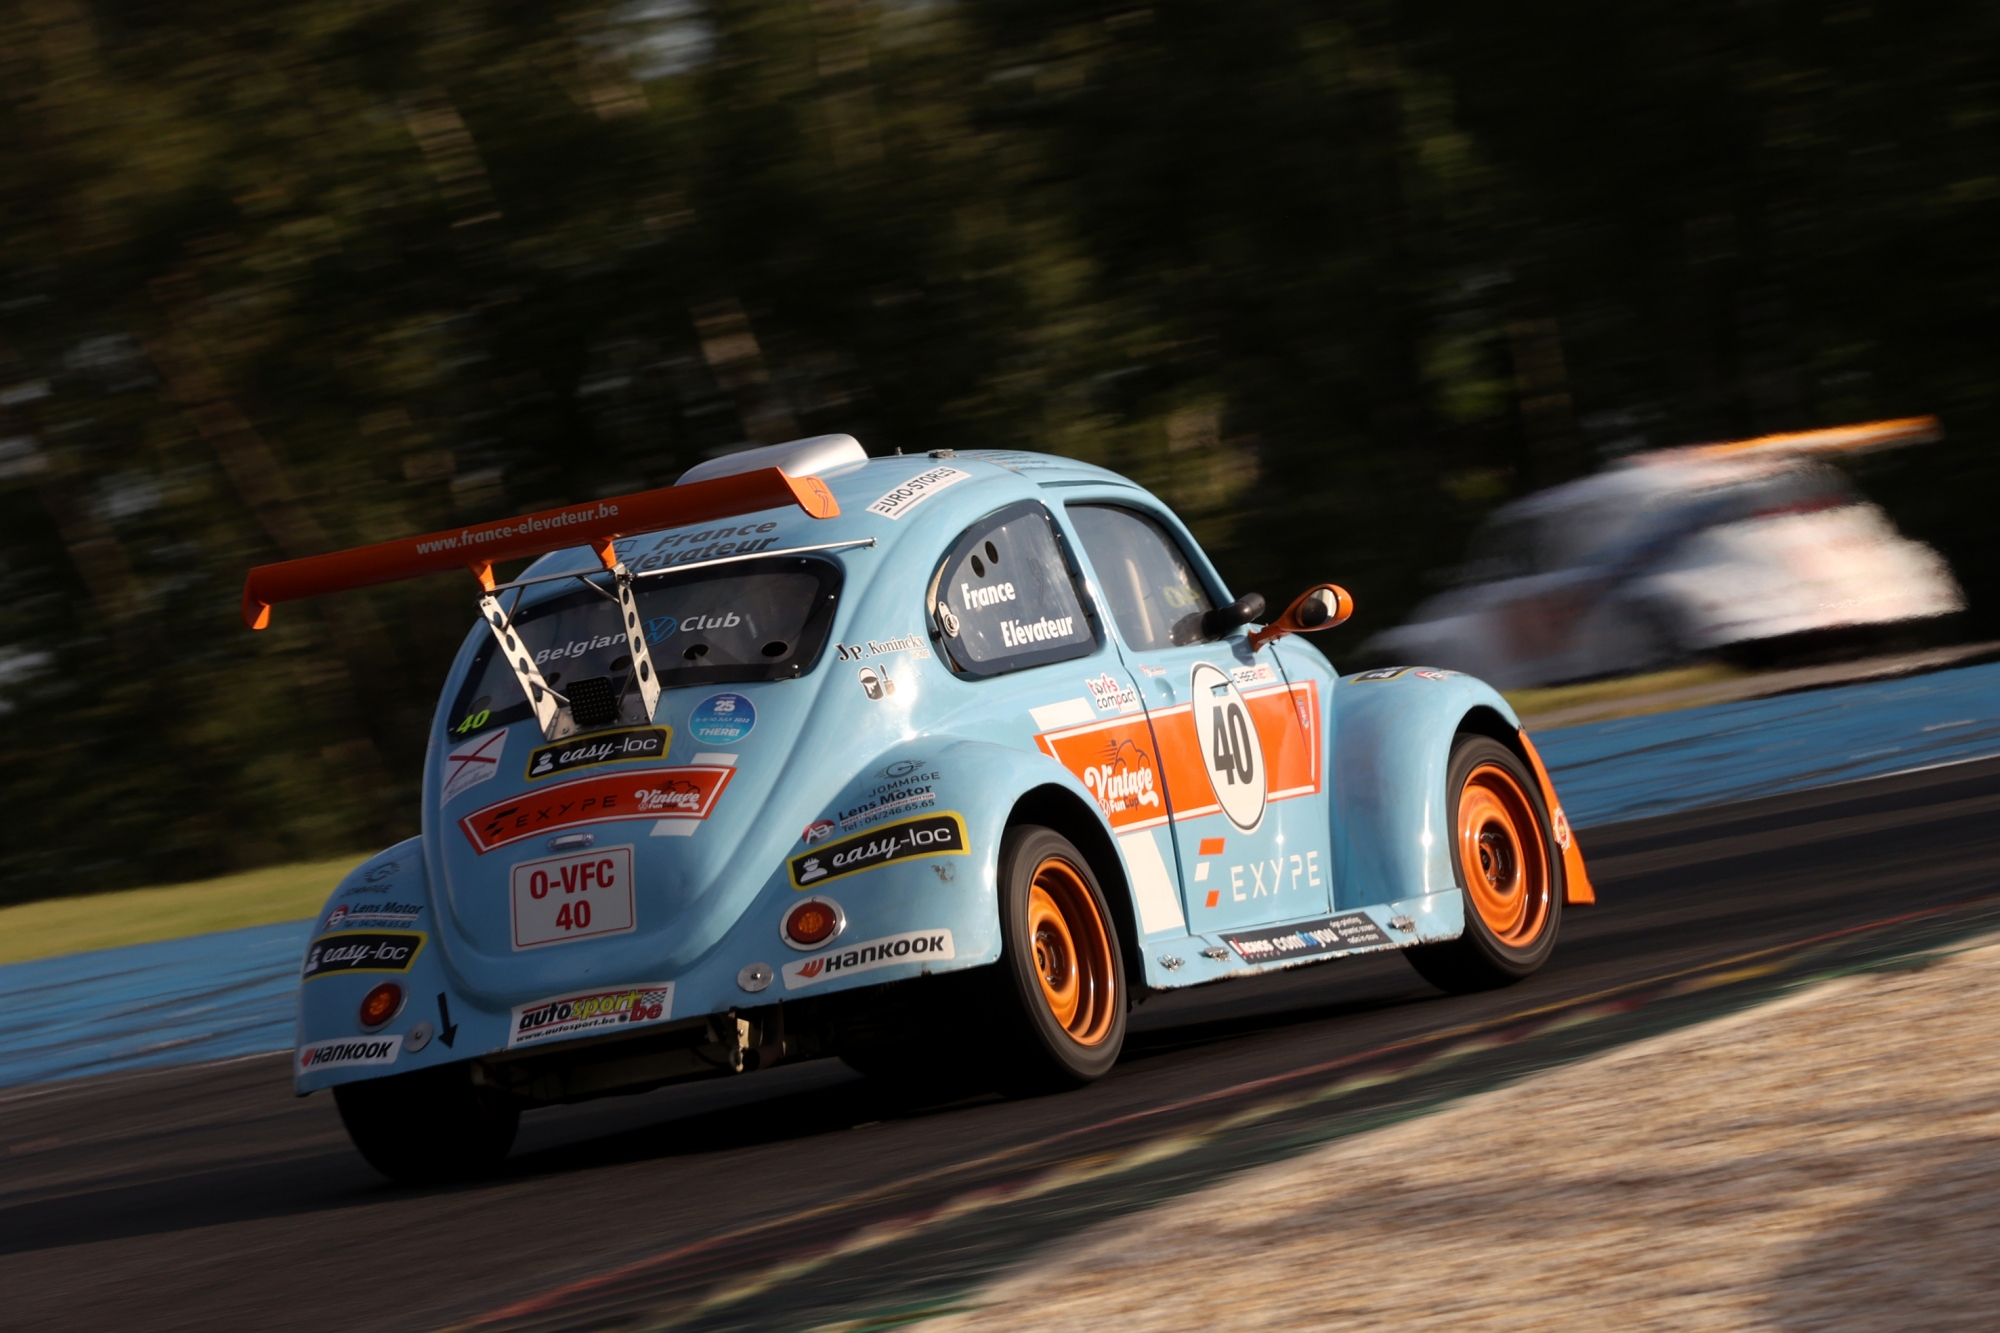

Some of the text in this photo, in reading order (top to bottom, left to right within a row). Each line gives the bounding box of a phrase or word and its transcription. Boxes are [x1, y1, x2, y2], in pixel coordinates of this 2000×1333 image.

[873, 467, 957, 514] EURO-STORES
[415, 503, 619, 555] www.france-elevateur.be
[652, 521, 777, 551] France
[961, 581, 1016, 611] France
[534, 631, 628, 667] Belgian
[680, 611, 741, 632] Club
[867, 634, 925, 656] Koninckx
[1001, 616, 1074, 648] Elévateur
[714, 700, 735, 712] 25
[1096, 686, 1137, 712] compact
[456, 709, 491, 734] 40
[699, 728, 741, 737] THERE!
[559, 737, 658, 764] easy-loc
[1213, 702, 1254, 786] 40
[868, 771, 941, 798] JOMMAGE
[1084, 764, 1160, 808] Vintage
[514, 788, 701, 829] EXYPE Vintage
[838, 784, 932, 822] Lens Motor
[841, 821, 859, 833] Tel
[865, 799, 935, 825] 04/246.65.65
[832, 827, 952, 869] easy-loc
[1230, 850, 1322, 903] EXYPE
[351, 902, 425, 915] Lens Motor
[555, 899, 596, 932] 40
[322, 941, 410, 967] easy-loc
[516, 1016, 617, 1042] www.autosport.be
